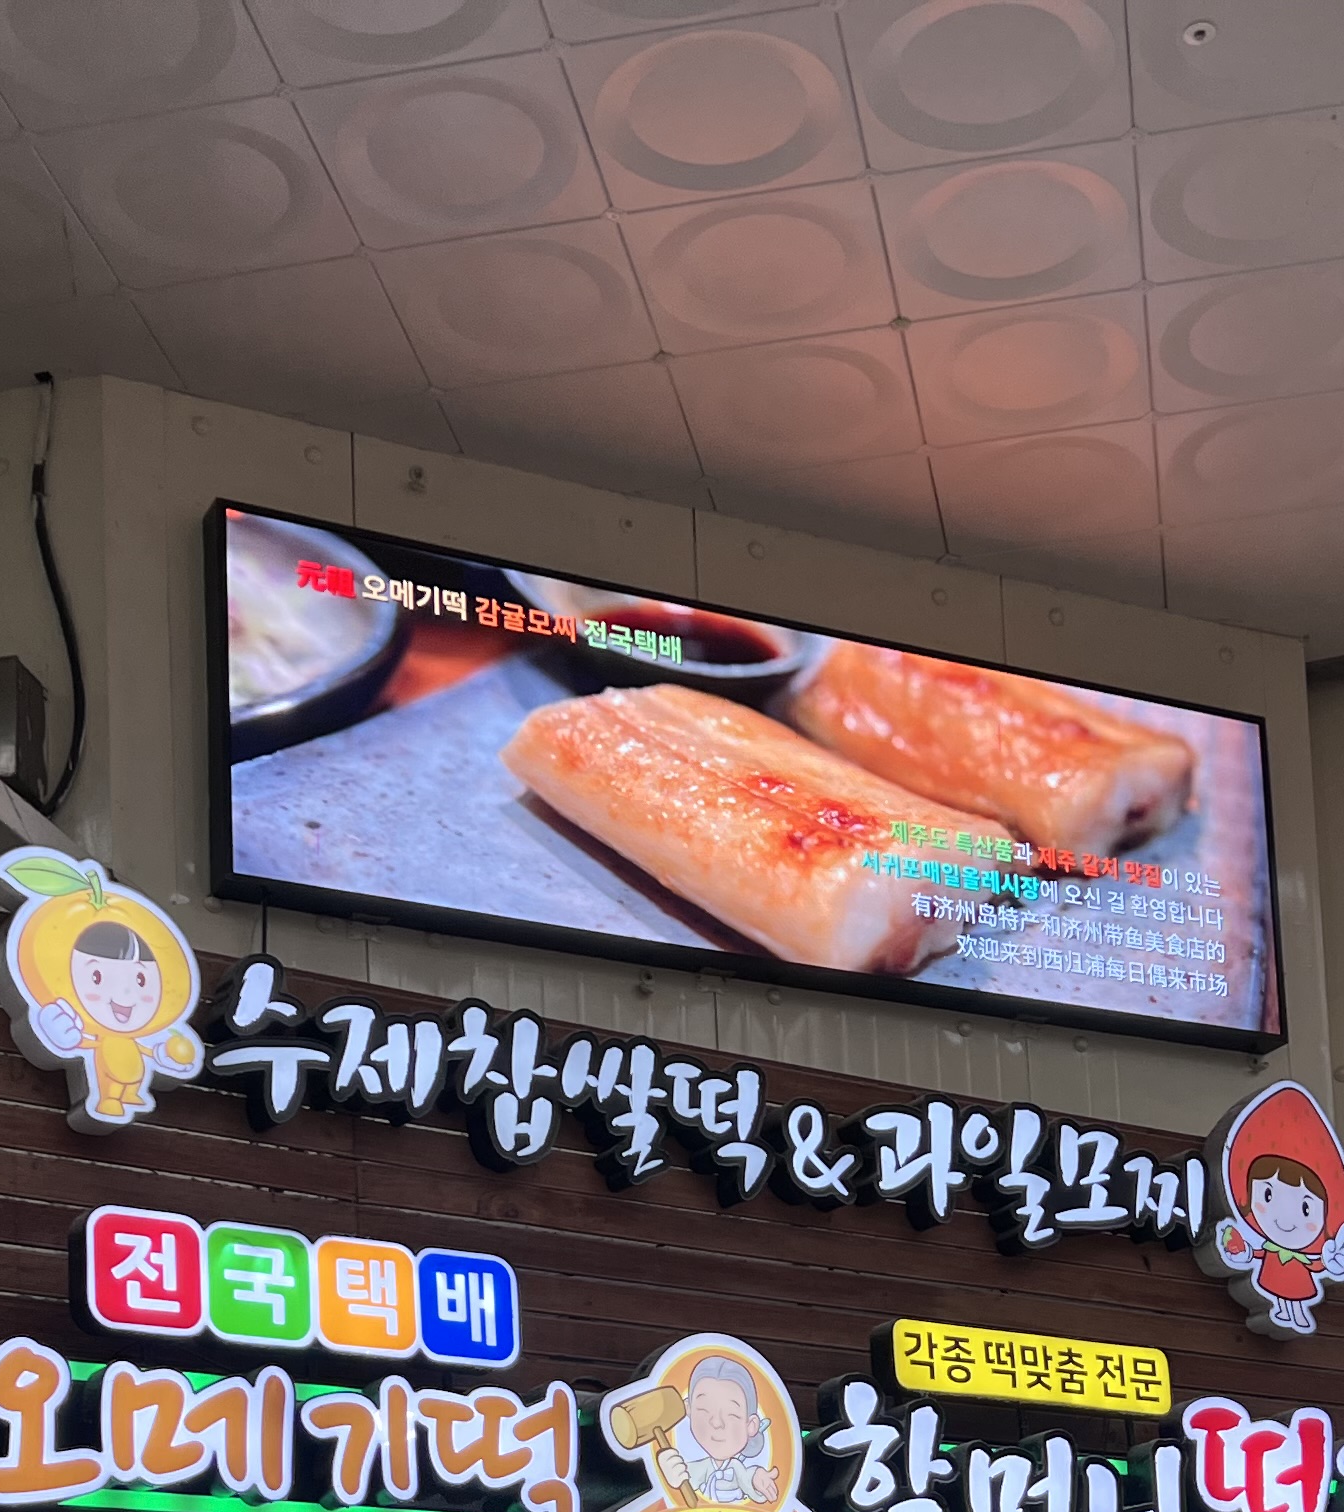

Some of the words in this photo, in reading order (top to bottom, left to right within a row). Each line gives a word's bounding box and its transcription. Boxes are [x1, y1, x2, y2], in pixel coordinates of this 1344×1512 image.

[362, 575, 467, 621] 오메기떡
[475, 596, 577, 644] 감귤모찌
[584, 618, 684, 664] 전국택배
[861, 850, 1058, 904] 서귀포매일올레시장에
[1065, 884, 1102, 911] 오신
[1107, 891, 1126, 915] 걸
[1130, 894, 1223, 931] 환영합니다
[889, 821, 950, 850] 제주도
[955, 831, 1033, 866] 특산품과
[1038, 846, 1076, 874] 제주
[1082, 853, 1119, 881] 갈치
[1124, 861, 1179, 890] 맛집이
[1184, 871, 1221, 898] 있는
[911, 892, 1226, 964] 有济州岛特产和济州带鱼美食店的
[957, 934, 1229, 997] 欢迎来到西归浦每日偶来市场
[213, 961, 763, 1186] 수제찹쌀떡
[788, 1104, 856, 1197] &
[866, 1100, 1206, 1250] 과일모찌
[111, 1232, 498, 1347] 전국택배
[904, 1331, 975, 1384] 각종
[983, 1340, 1088, 1395] 떡맞춤
[1095, 1354, 1162, 1403] 전문
